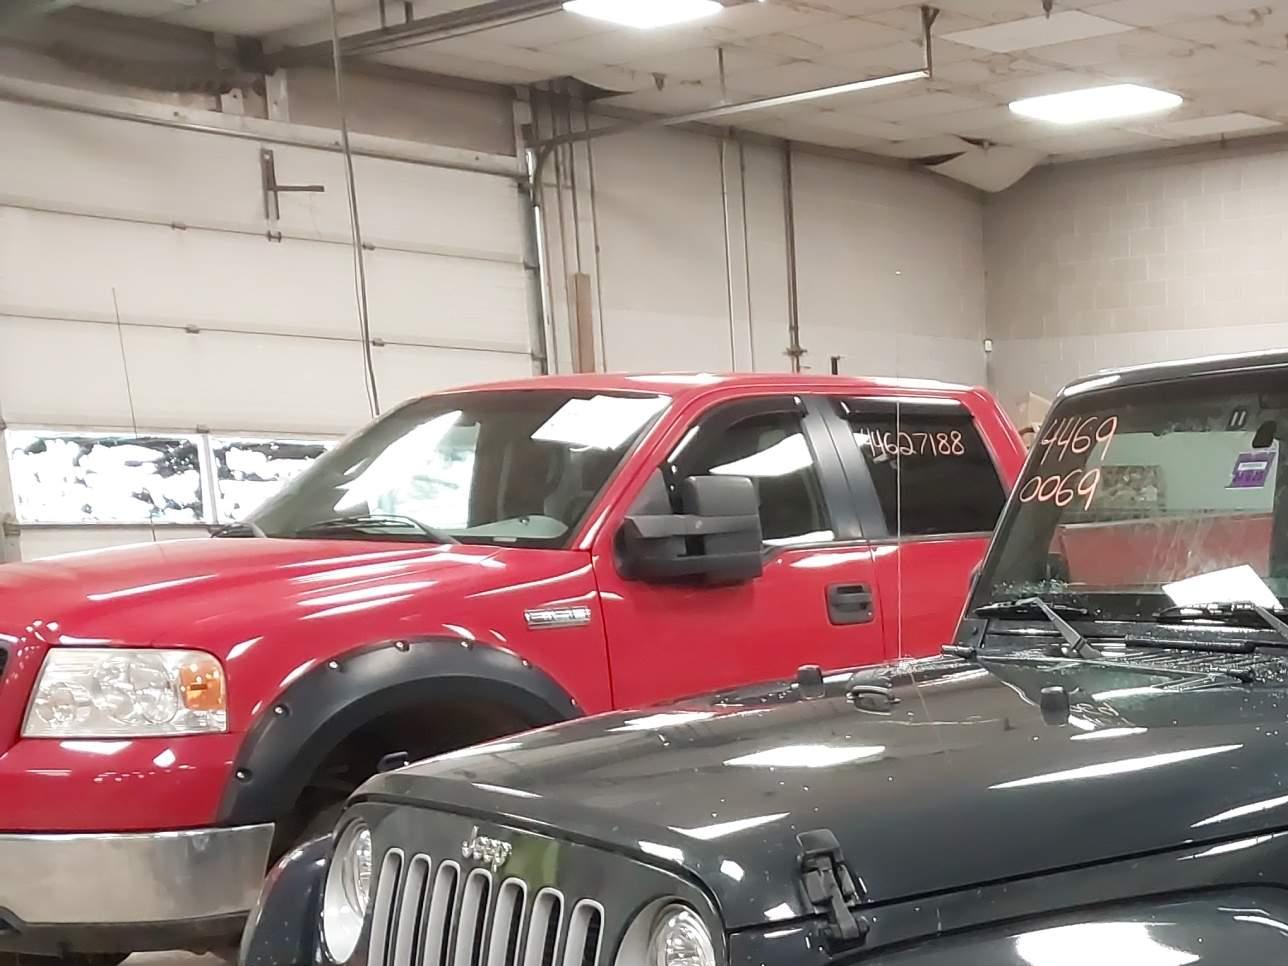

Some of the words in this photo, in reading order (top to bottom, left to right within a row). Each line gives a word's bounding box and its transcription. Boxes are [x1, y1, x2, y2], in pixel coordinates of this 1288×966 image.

[859, 428, 965, 457] 44627188
[1040, 416, 1118, 465] 4469
[1020, 468, 1100, 511] 0069
[461, 825, 512, 872] Jeep
